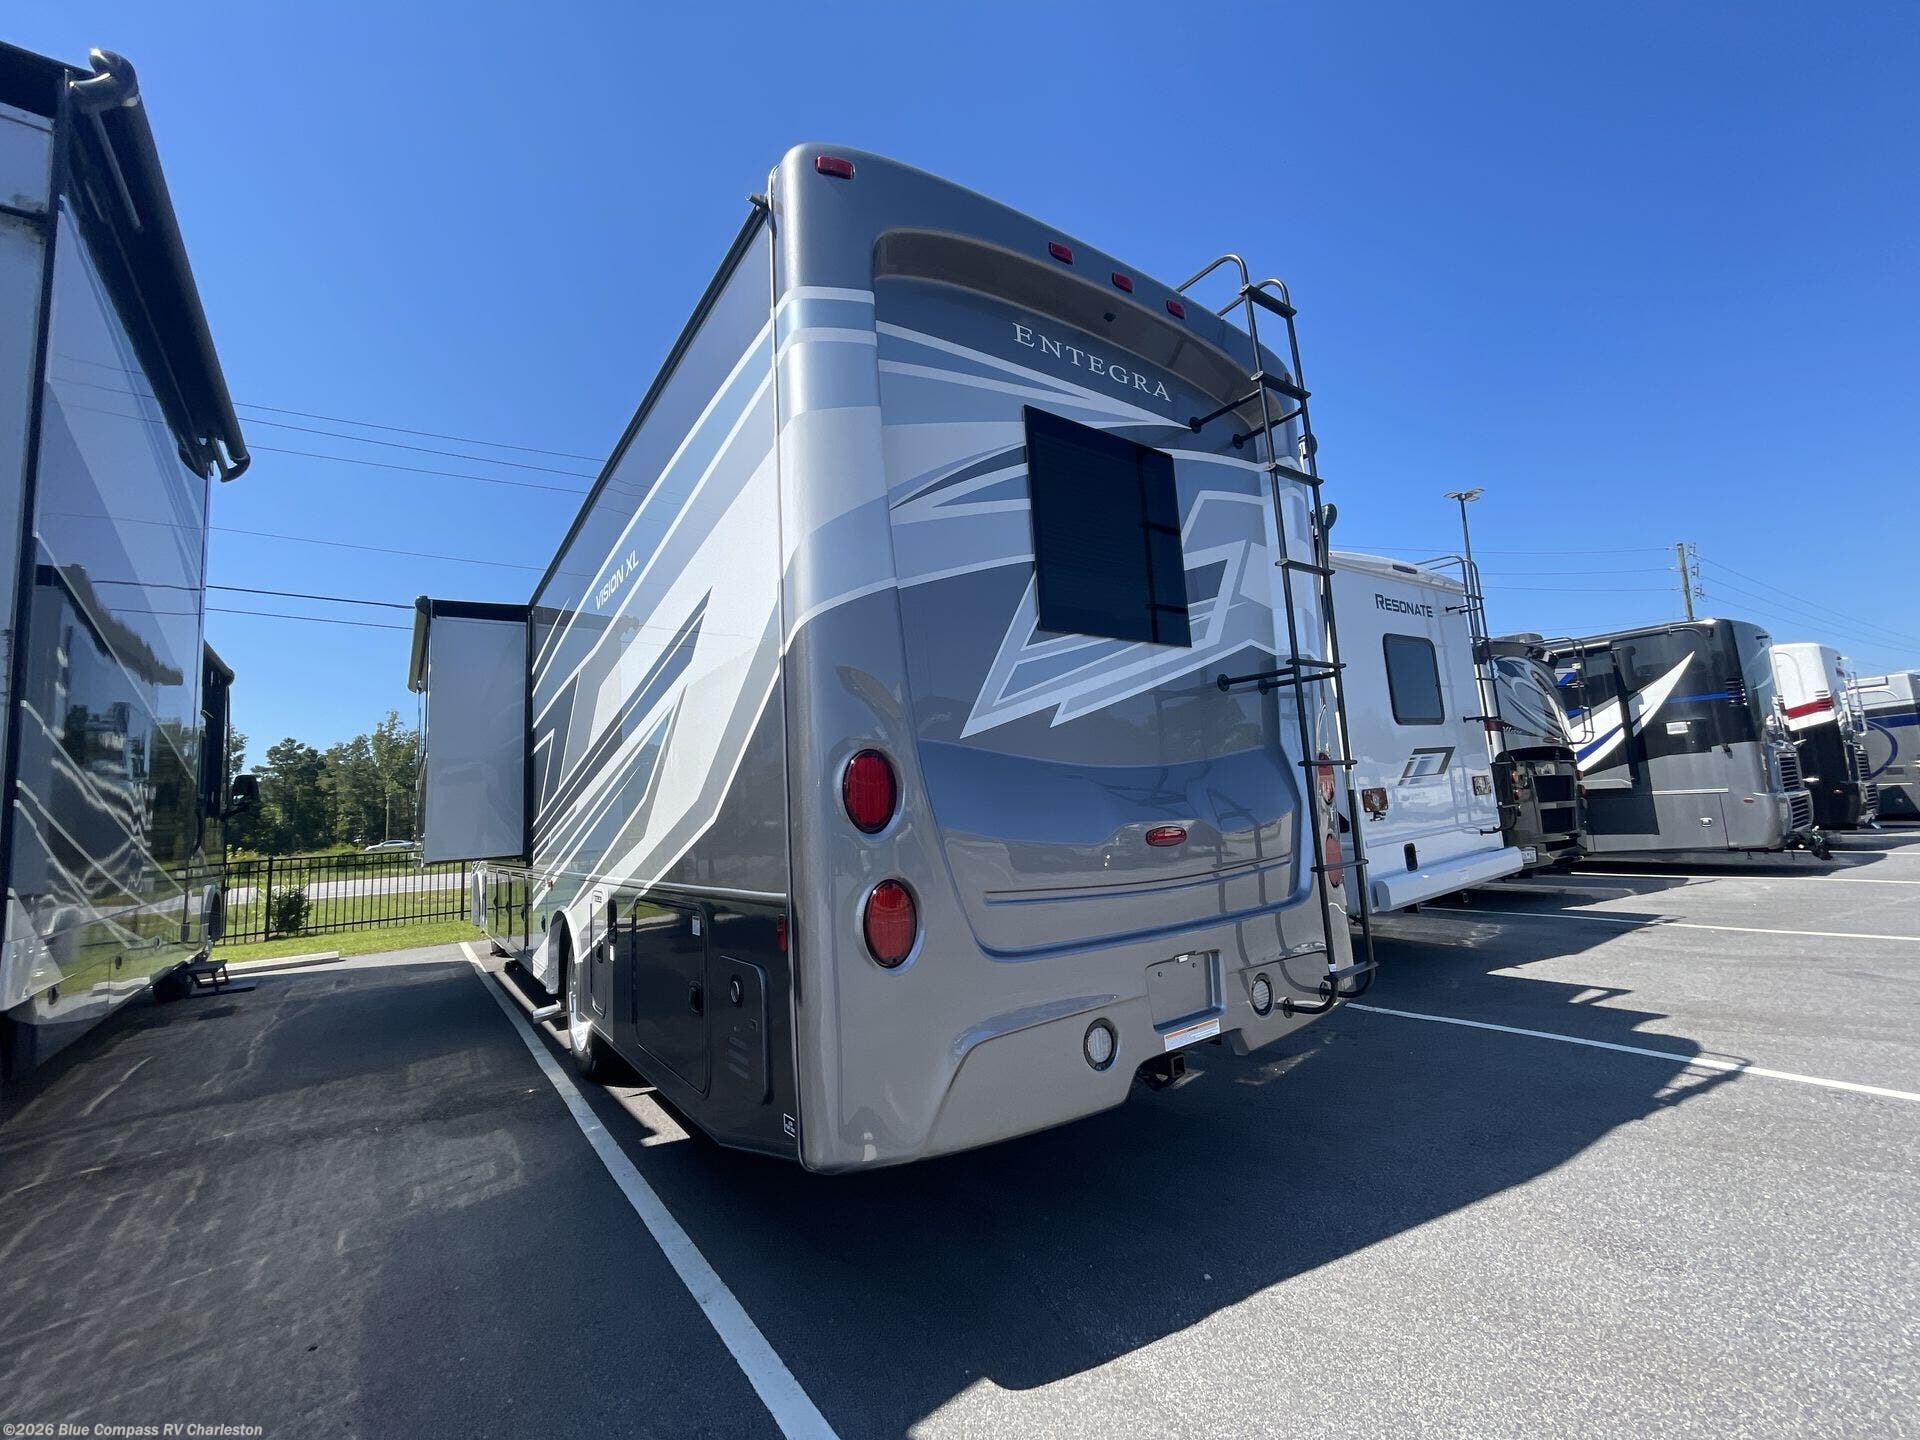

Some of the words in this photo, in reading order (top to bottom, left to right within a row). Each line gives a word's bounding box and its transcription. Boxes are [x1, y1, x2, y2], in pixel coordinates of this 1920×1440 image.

[1012, 322, 1172, 402] ENTEGRA
[595, 564, 624, 610] VISION
[625, 549, 639, 577] XL
[1374, 593, 1434, 618] RESONATE
